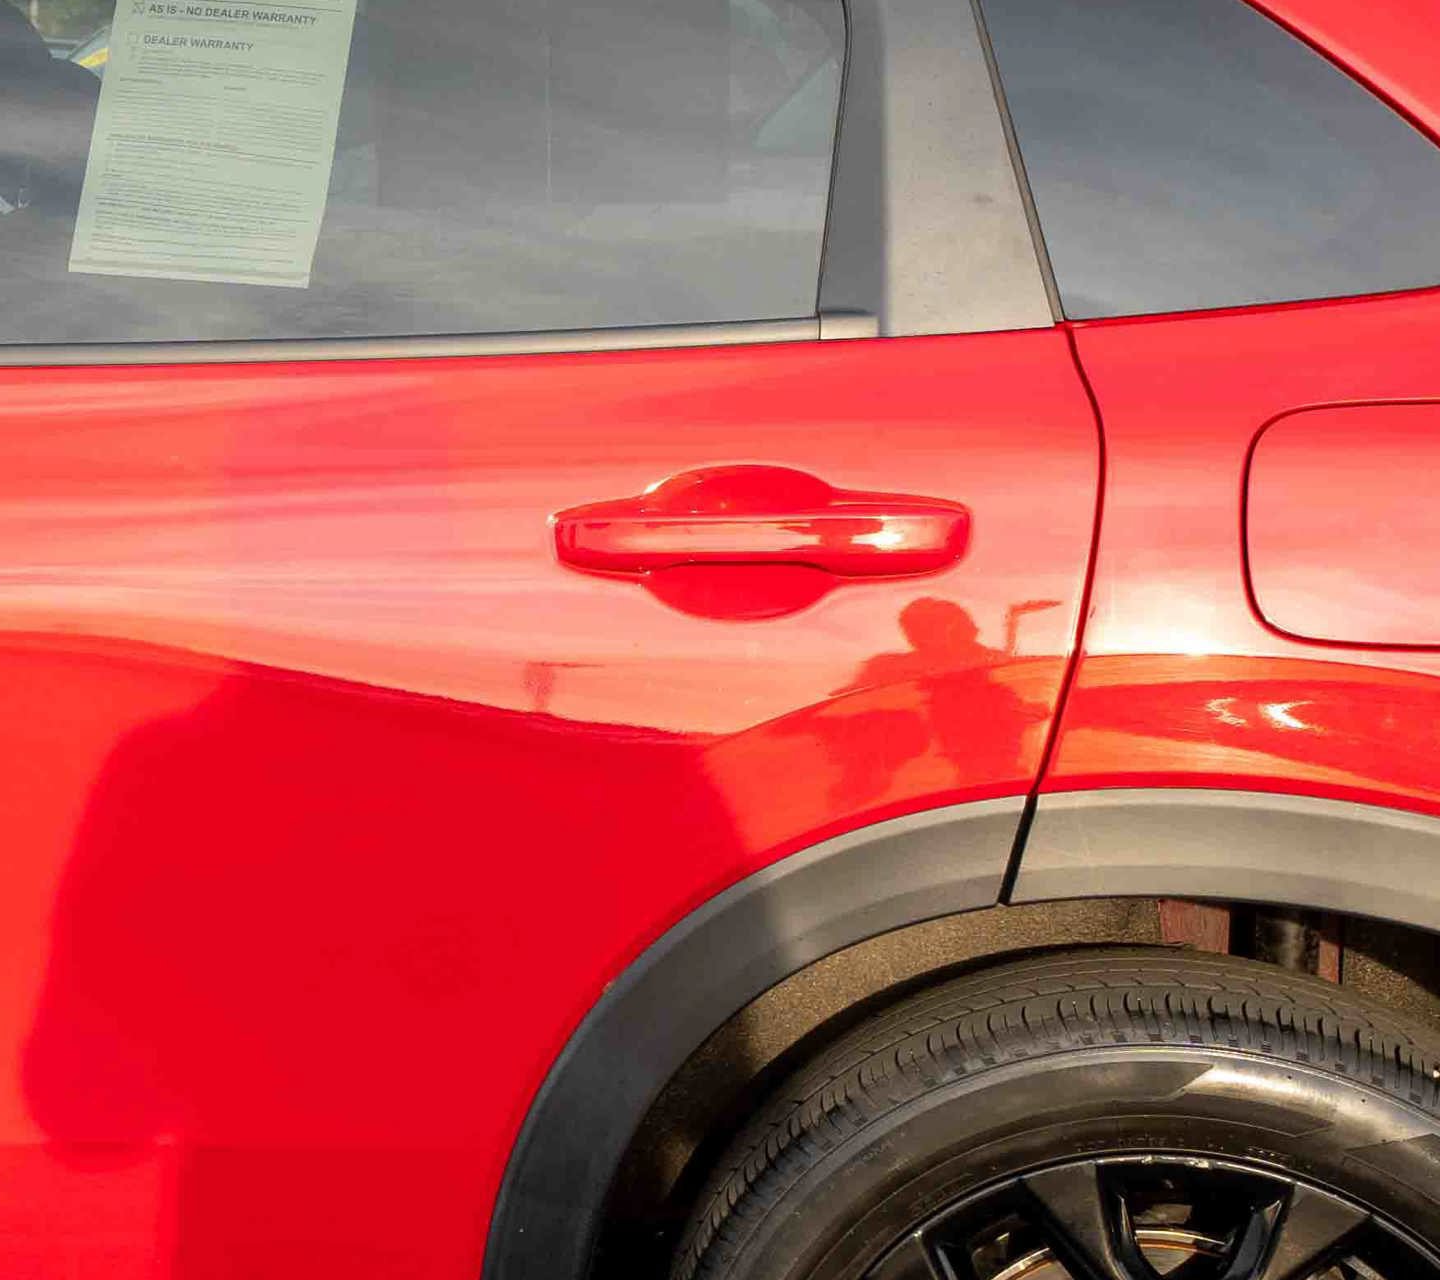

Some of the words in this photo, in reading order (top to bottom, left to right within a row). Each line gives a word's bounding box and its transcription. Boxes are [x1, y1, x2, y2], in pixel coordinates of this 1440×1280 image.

[149, 4, 163, 13] AS
[166, 5, 177, 15] IS
[186, 6, 202, 16] NO
[205, 7, 249, 19] DEALER
[252, 11, 317, 25] WARRANTY
[143, 34, 188, 47] DEALER
[190, 38, 255, 51] WARRANTY
